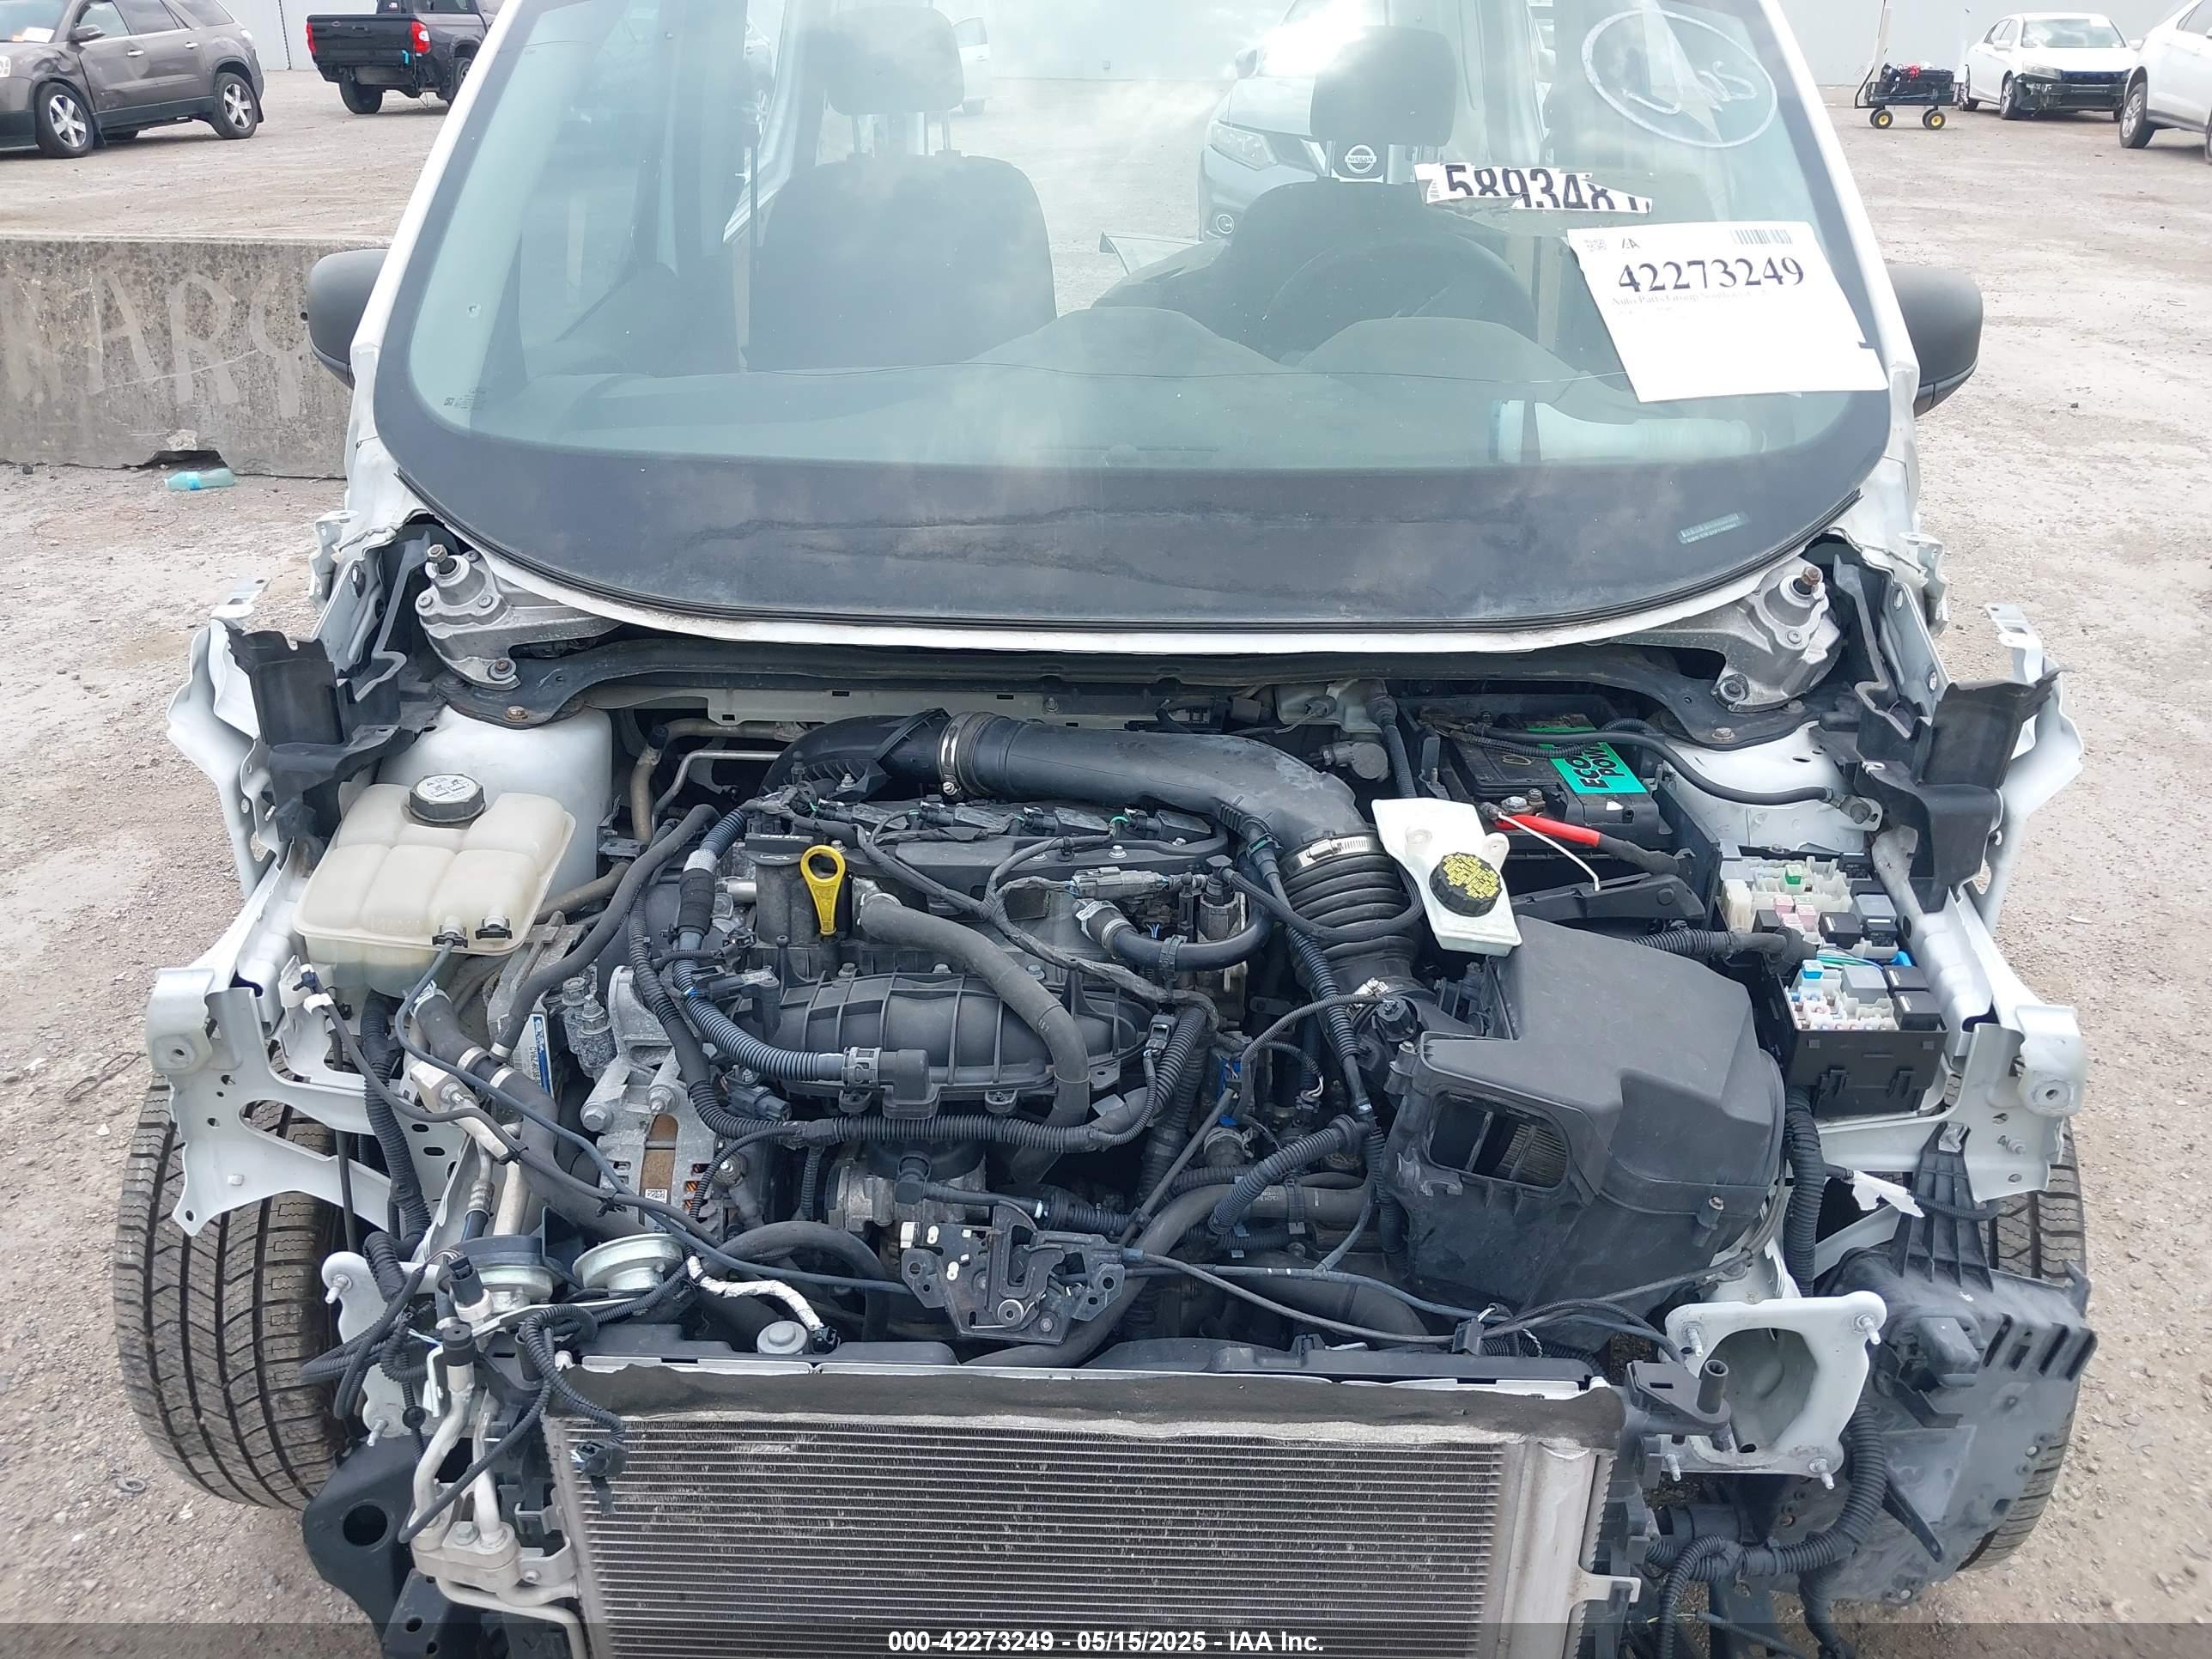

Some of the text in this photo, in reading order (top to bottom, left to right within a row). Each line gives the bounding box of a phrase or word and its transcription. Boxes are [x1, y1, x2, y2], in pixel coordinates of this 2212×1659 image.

[1618, 256, 1805, 293] 42273249
[1564, 756, 1611, 788] ECO
[1582, 743, 1626, 776] POW
